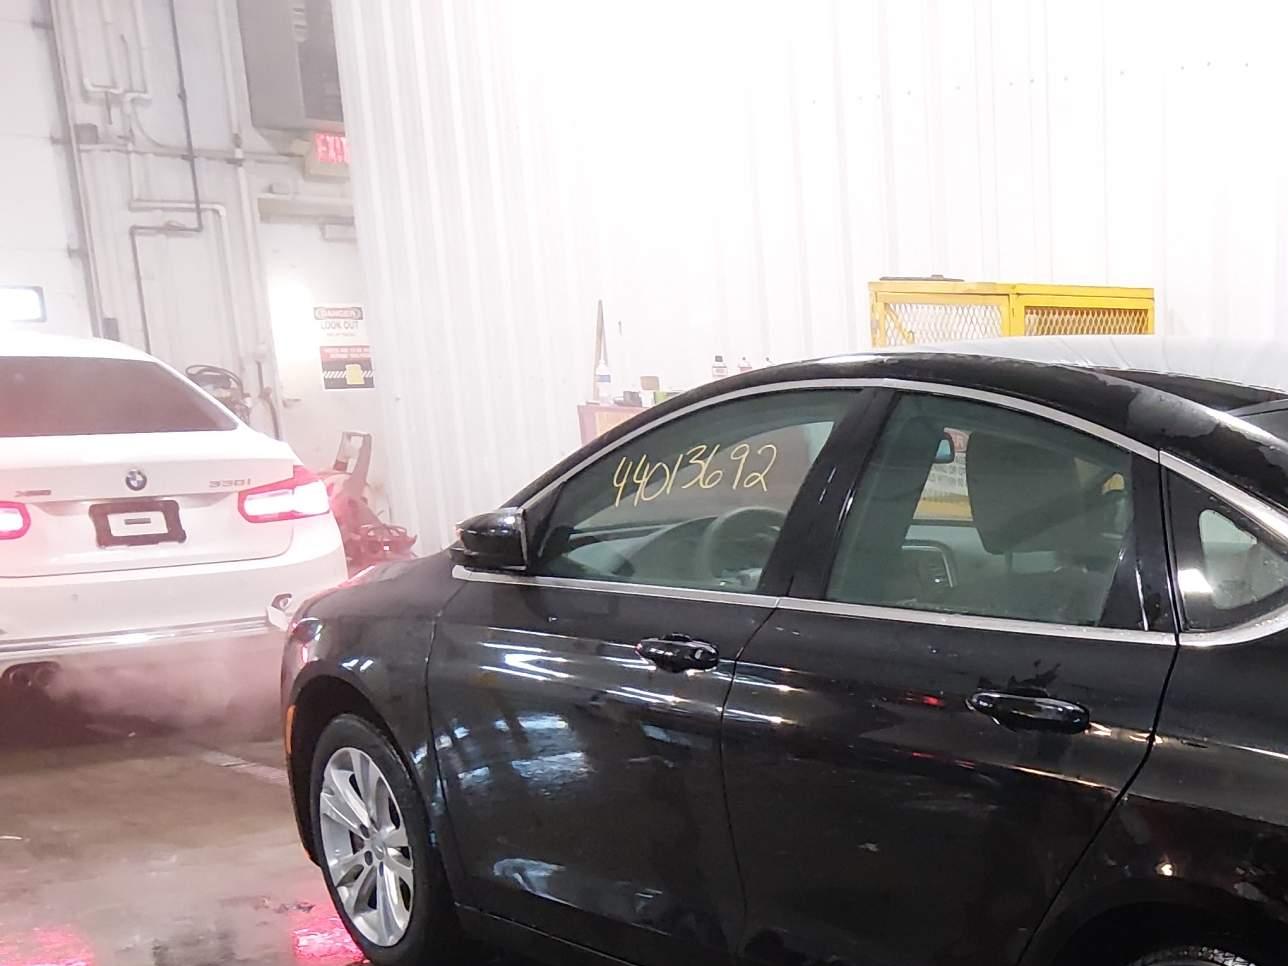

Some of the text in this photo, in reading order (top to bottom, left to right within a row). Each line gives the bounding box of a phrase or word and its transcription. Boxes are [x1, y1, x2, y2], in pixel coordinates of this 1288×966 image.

[320, 320, 359, 330] LOOK OUT
[612, 443, 778, 508] 44013692
